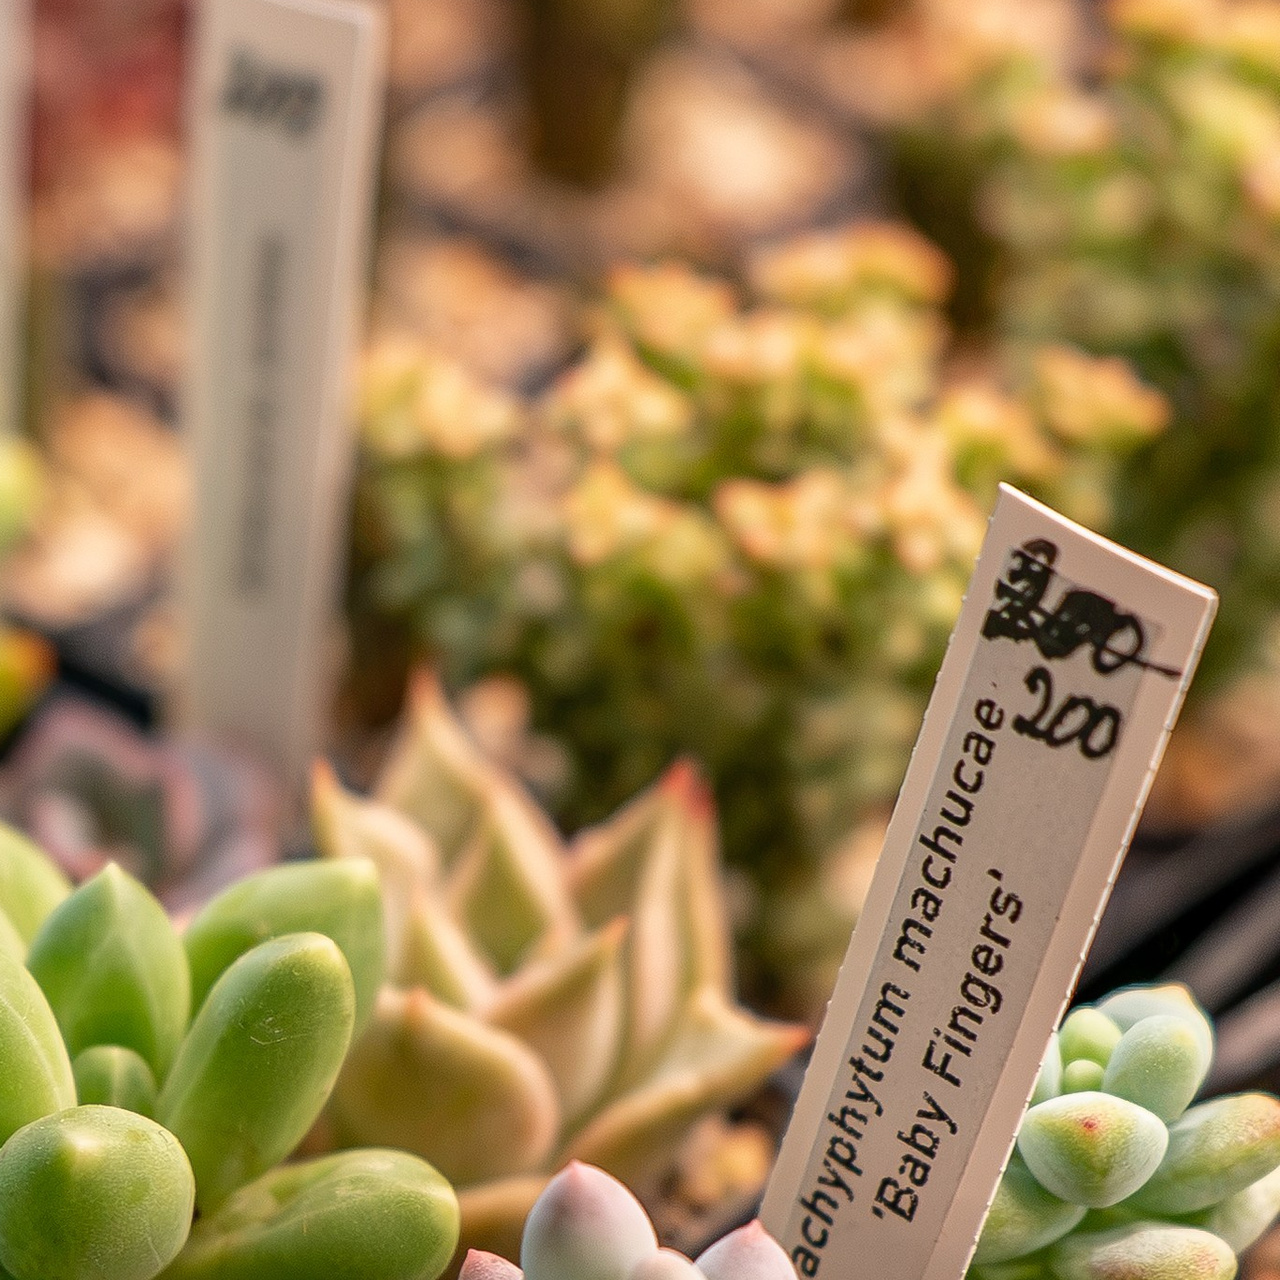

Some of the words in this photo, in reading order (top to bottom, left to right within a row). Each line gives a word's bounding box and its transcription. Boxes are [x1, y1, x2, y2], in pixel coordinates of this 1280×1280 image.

[1012, 666, 1122, 760] 200
[791, 982, 911, 1279] achyphytum
[892, 698, 1005, 973] machucae
[872, 1095, 958, 1223] 'Baby
[922, 868, 1024, 1088] Fingers'
